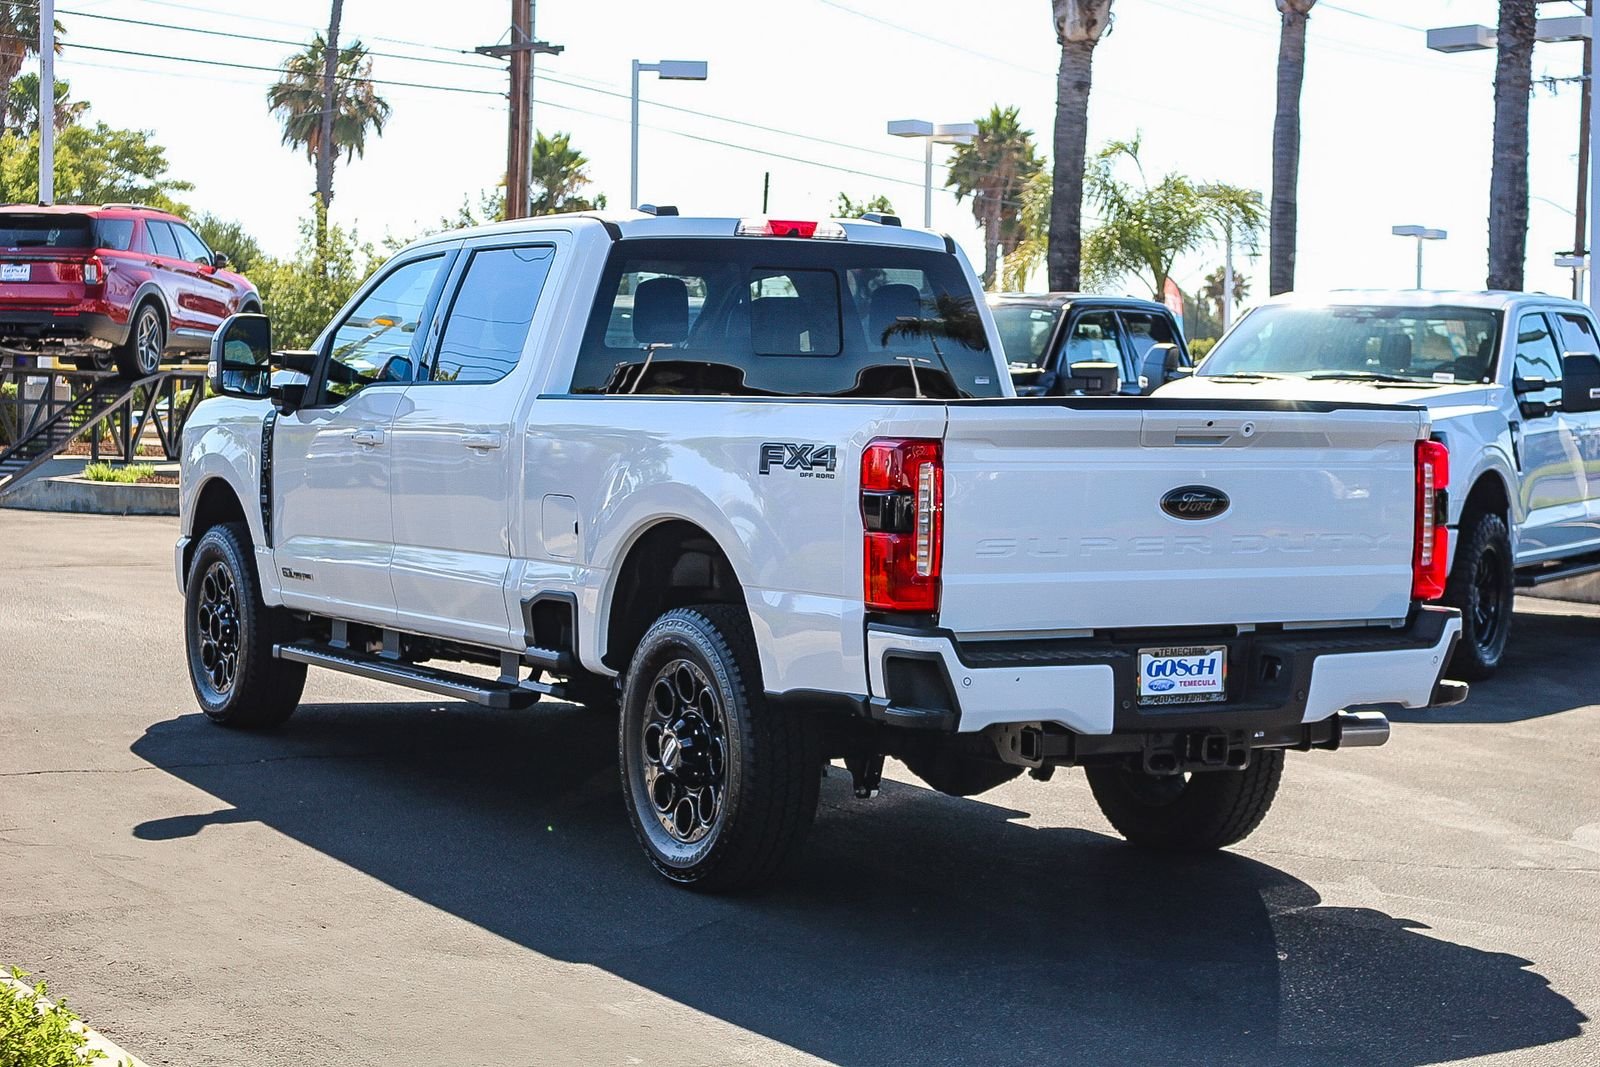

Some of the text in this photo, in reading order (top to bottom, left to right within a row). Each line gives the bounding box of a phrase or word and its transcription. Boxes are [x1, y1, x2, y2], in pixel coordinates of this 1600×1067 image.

[759, 442, 837, 475] FX4
[1178, 492, 1217, 512] Ford
[975, 533, 1392, 559] SUPER DUTY
